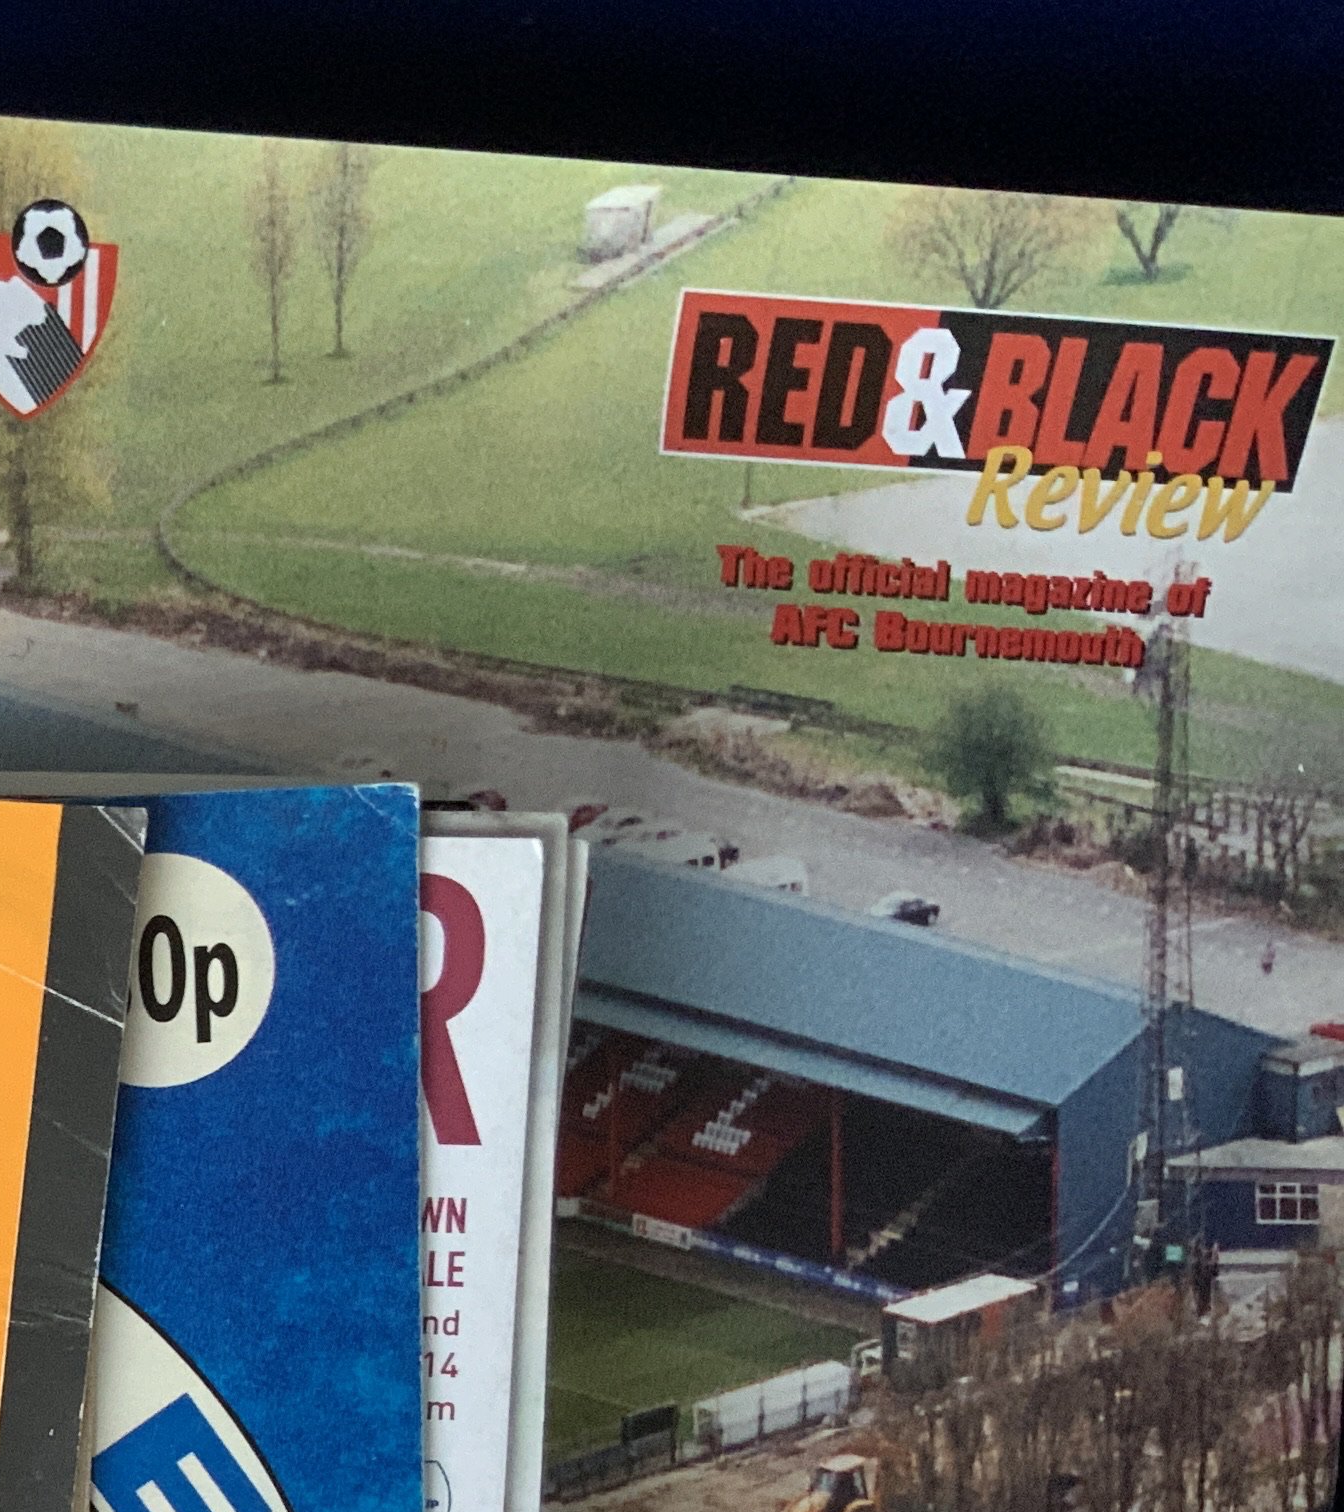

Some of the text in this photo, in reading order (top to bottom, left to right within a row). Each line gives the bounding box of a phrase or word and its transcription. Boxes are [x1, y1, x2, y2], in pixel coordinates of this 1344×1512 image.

[967, 446, 1275, 542] Review
[717, 545, 1212, 618] The official magazine of
[771, 604, 1146, 668] AFC Bournemouth
[127, 914, 239, 1043] 0p
